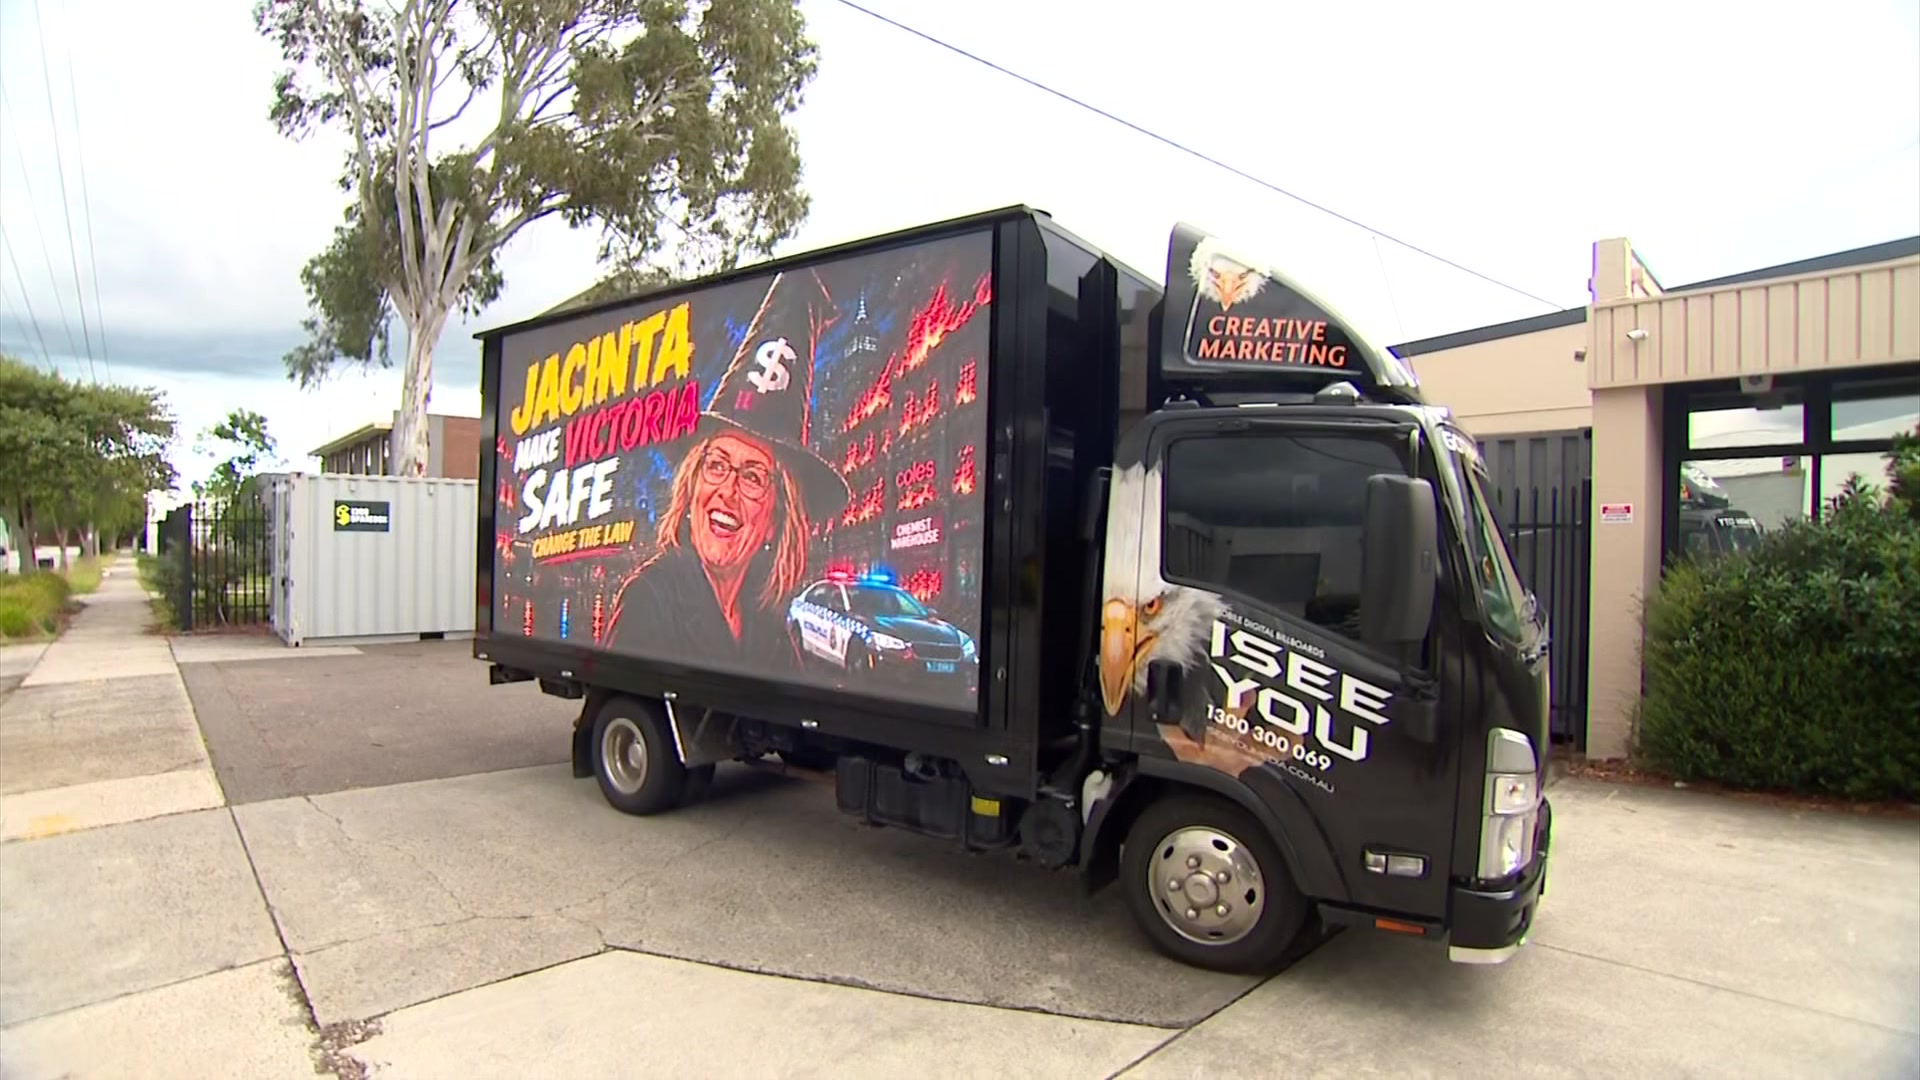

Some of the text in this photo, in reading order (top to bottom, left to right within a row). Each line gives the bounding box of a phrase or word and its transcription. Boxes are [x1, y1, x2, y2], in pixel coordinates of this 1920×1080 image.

[1208, 316, 1327, 342] CREATIVE
[511, 302, 696, 435] JACINTA
[1198, 338, 1347, 367] MARKETING
[513, 380, 699, 473] MAKE VICTORIA
[896, 460, 936, 487] coles
[518, 457, 620, 534] SAFE
[532, 520, 635, 558] CHANGE THE LAW
[891, 529, 940, 550] WAREHOUSE
[896, 517, 932, 536] CHEMIST
[1243, 617, 1274, 639] DIGITAL
[1275, 630, 1326, 660] BILLBOARDS
[1210, 662, 1369, 762] YOU
[1206, 704, 1332, 771] 1300 300 069
